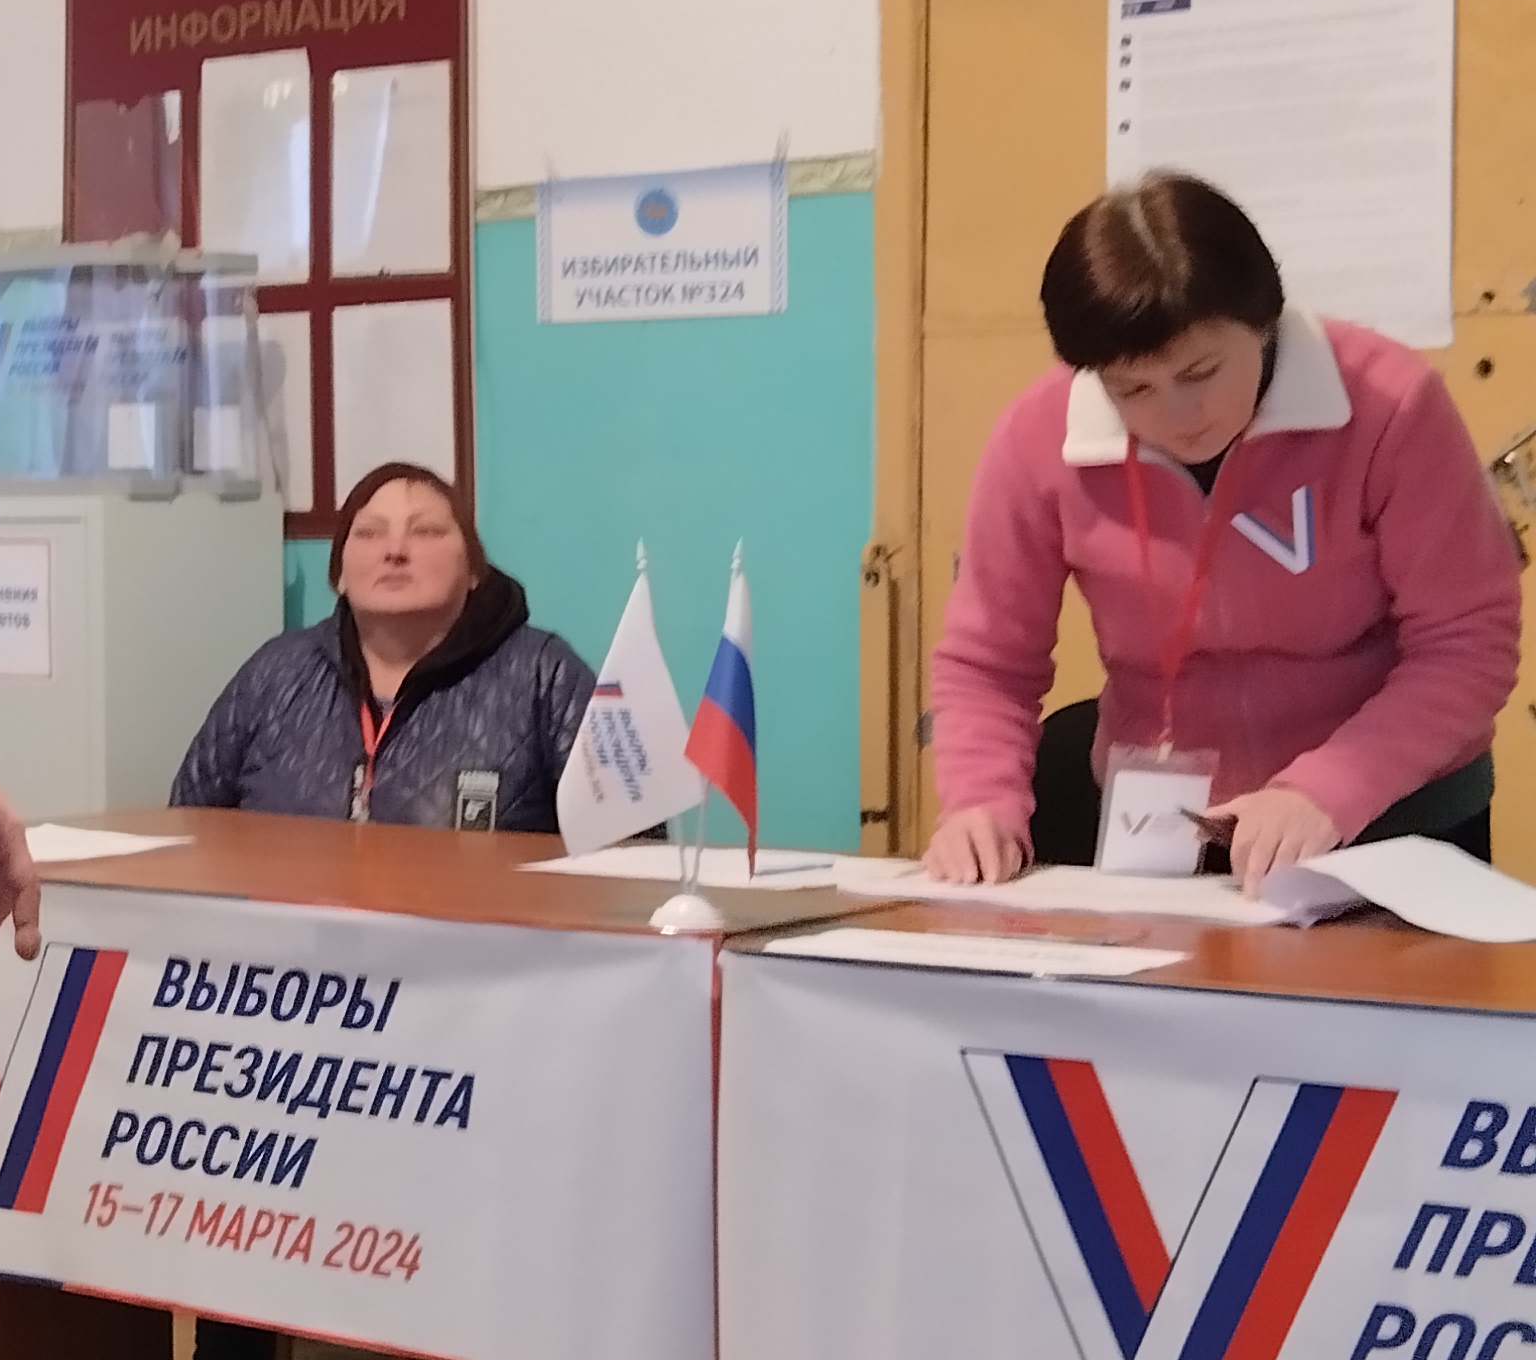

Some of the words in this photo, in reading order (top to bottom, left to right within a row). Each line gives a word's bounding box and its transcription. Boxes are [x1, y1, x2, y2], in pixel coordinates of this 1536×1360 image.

[562, 242, 760, 280] ИЗБИРАТЕЛЬНЫЙ
[575, 283, 674, 309] УЧАСТОК
[1230, 485, 1315, 576] V
[152, 954, 401, 1033] ВЫБОРЫ
[126, 1033, 476, 1130] ПРЕЗИДЕНТА
[100, 1109, 319, 1190] РОССИИ
[184, 1197, 316, 1263] МАРТА
[321, 1219, 423, 1281] 2024
